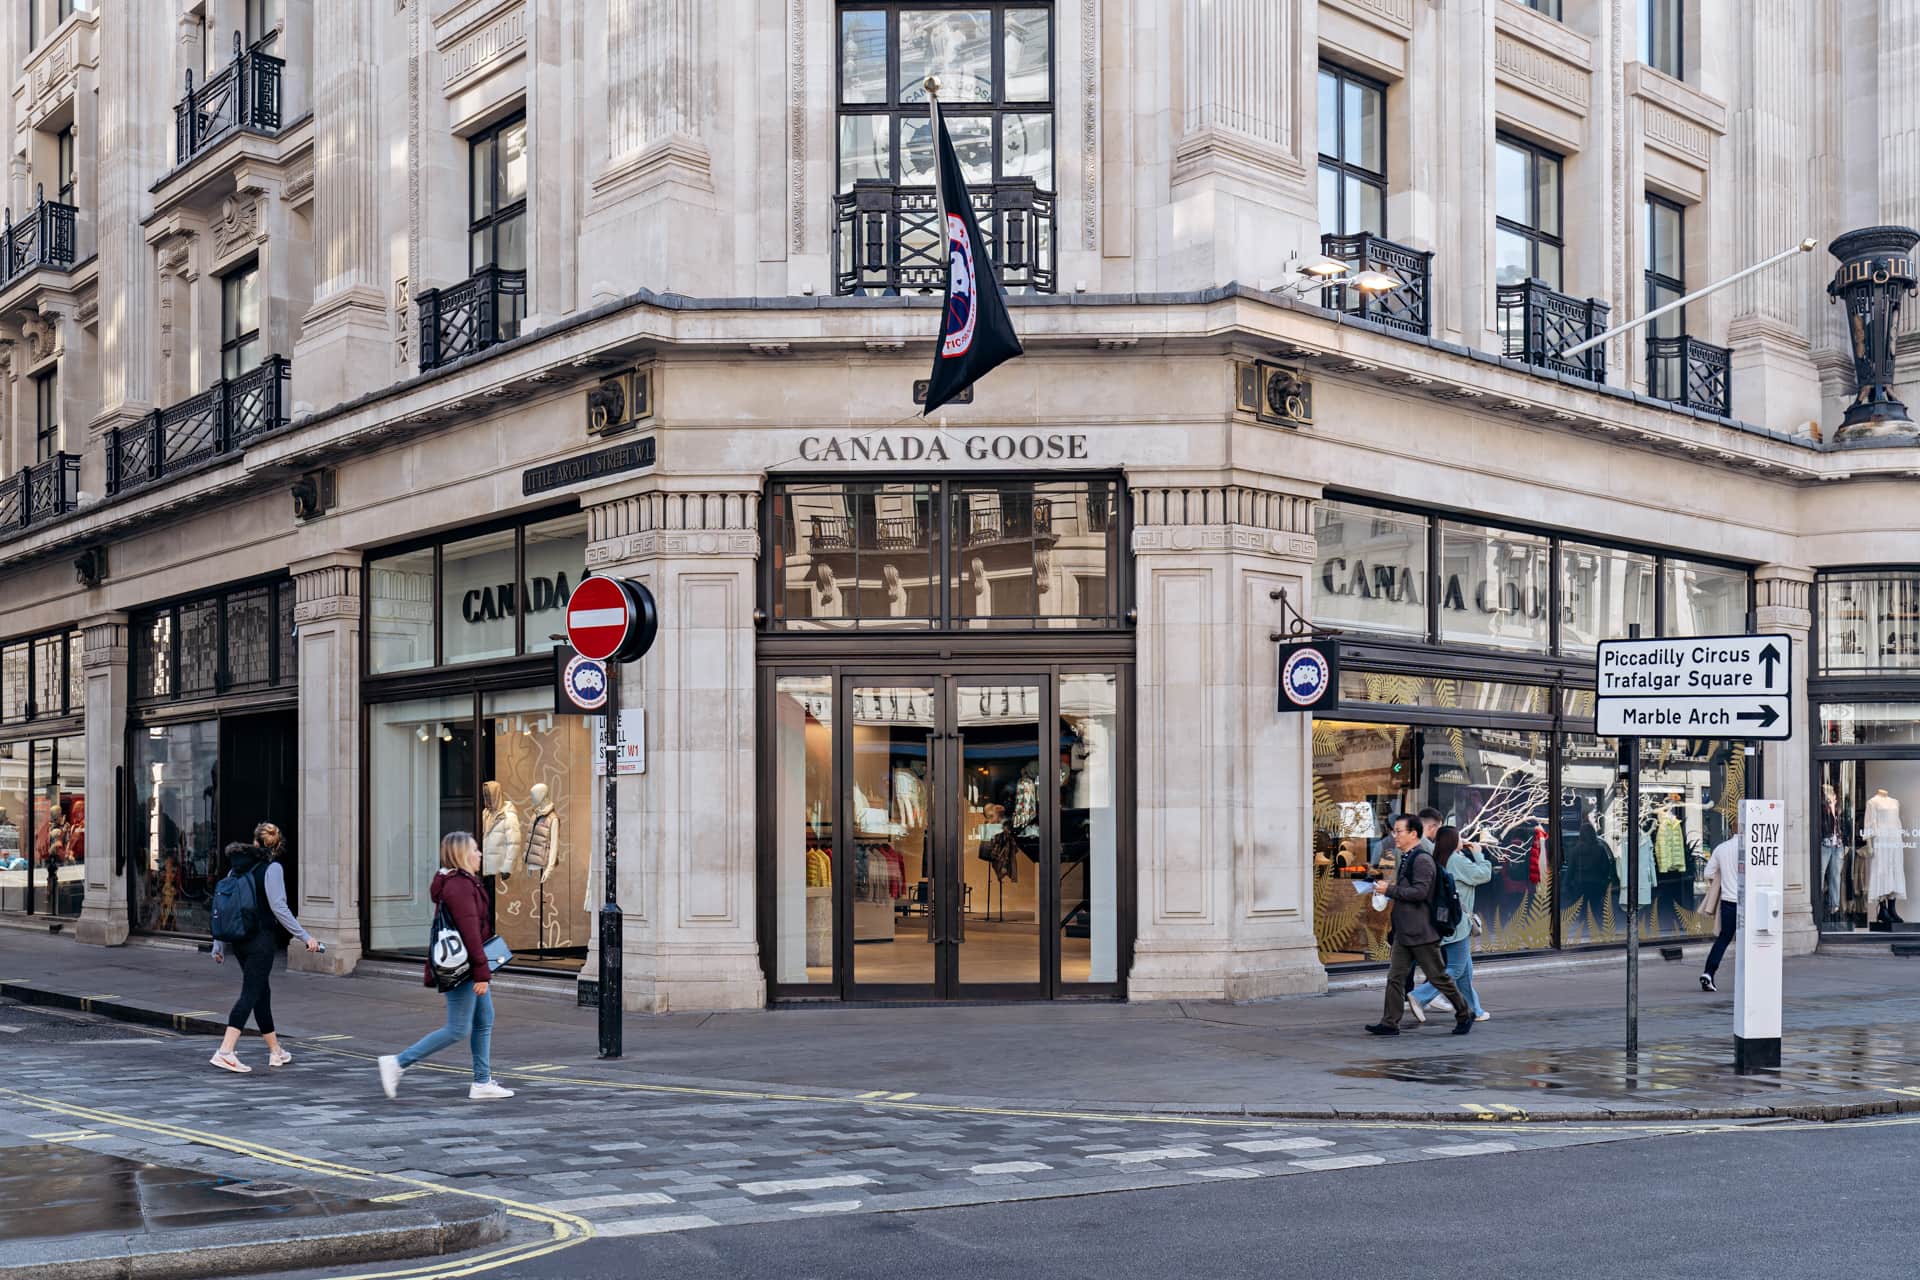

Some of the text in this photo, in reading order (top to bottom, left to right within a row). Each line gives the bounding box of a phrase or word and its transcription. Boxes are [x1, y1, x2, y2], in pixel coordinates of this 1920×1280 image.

[799, 434, 1088, 462] CANADA GOOSE
[556, 457, 593, 481] ARGYLL
[595, 446, 633, 473] STREET
[1322, 557, 1468, 611] CANAA
[1604, 647, 1751, 668] Piccadilly Circus
[1604, 670, 1753, 690] Trafalgar Square
[599, 712, 622, 729] LIE
[1623, 707, 1730, 725] Marble Arch
[627, 744, 640, 757] W1
[1751, 823, 1780, 844] STAY
[1751, 846, 1779, 866] SAFE
[440, 935, 463, 963] JD
